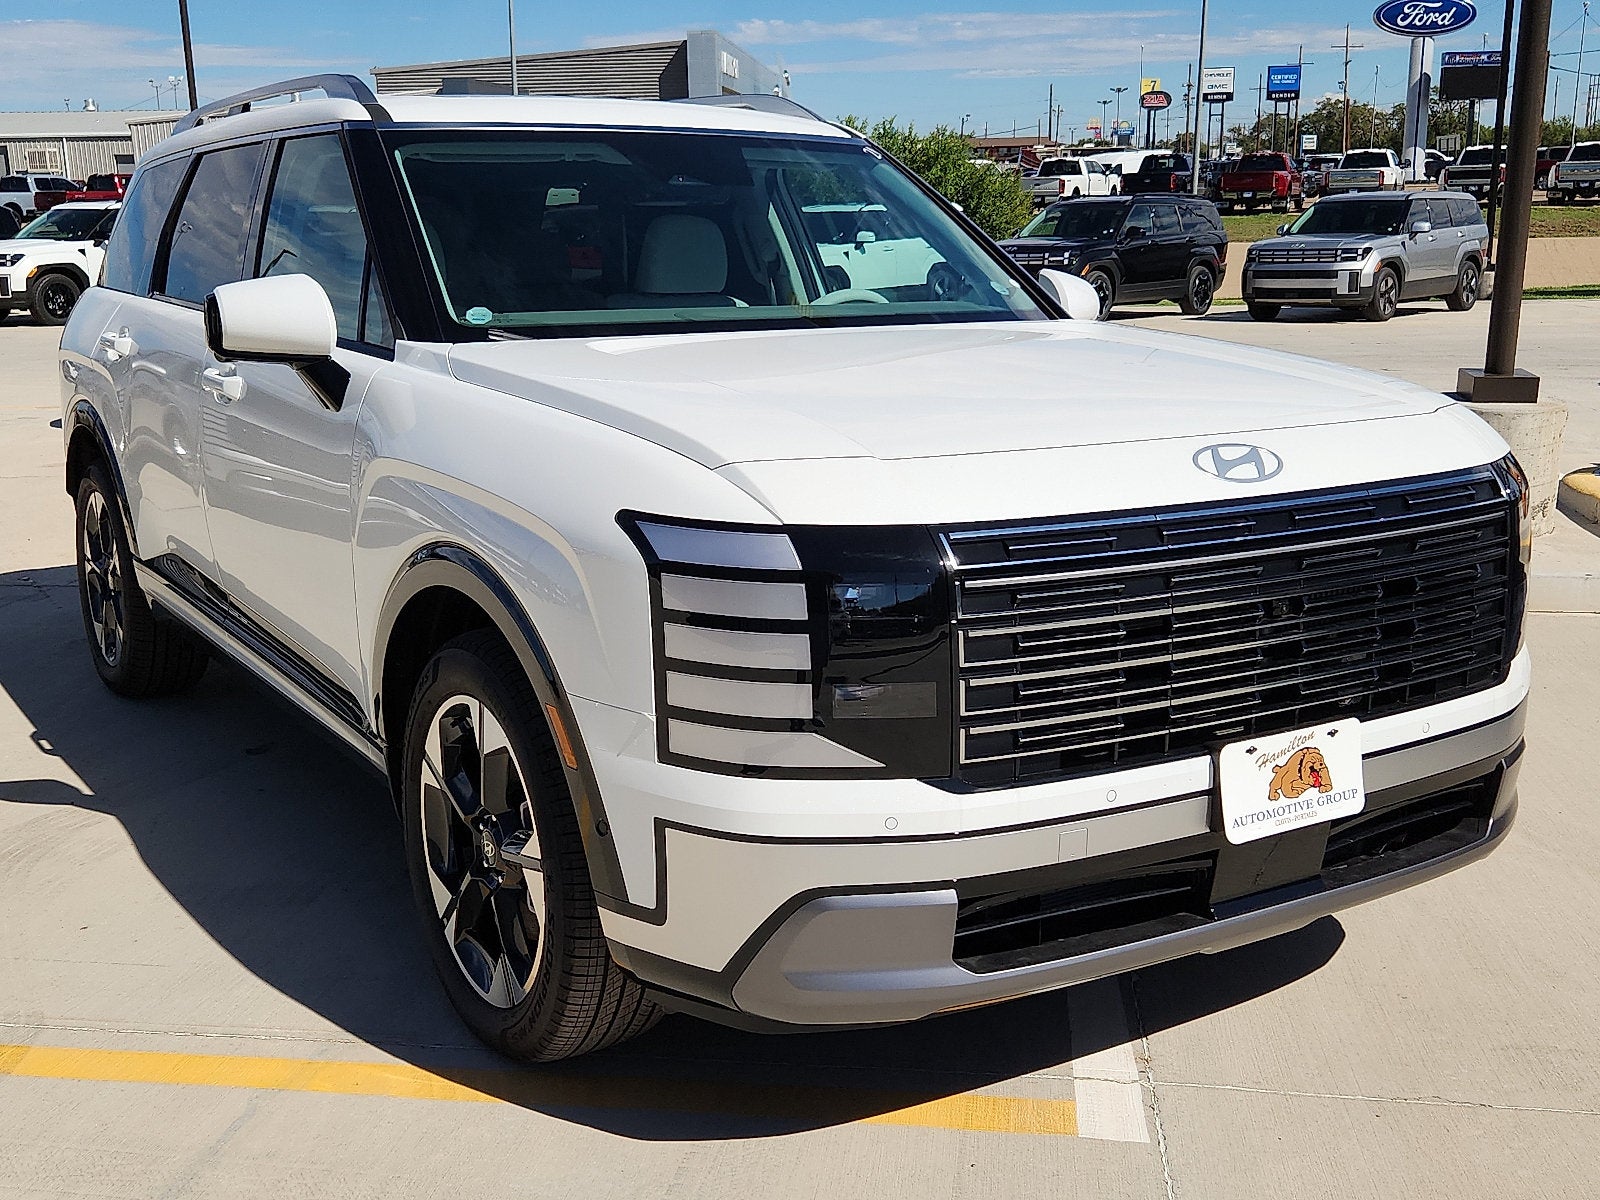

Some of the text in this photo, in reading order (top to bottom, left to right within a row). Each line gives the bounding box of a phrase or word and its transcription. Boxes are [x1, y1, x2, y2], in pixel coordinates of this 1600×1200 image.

[1396, 1, 1457, 26] Ford
[1143, 94, 1168, 107] ZIA
[1254, 731, 1316, 771] Hamilton
[1232, 788, 1358, 829] AUTOMOTIVE GROUP
[528, 908, 555, 1026] SCORPION
